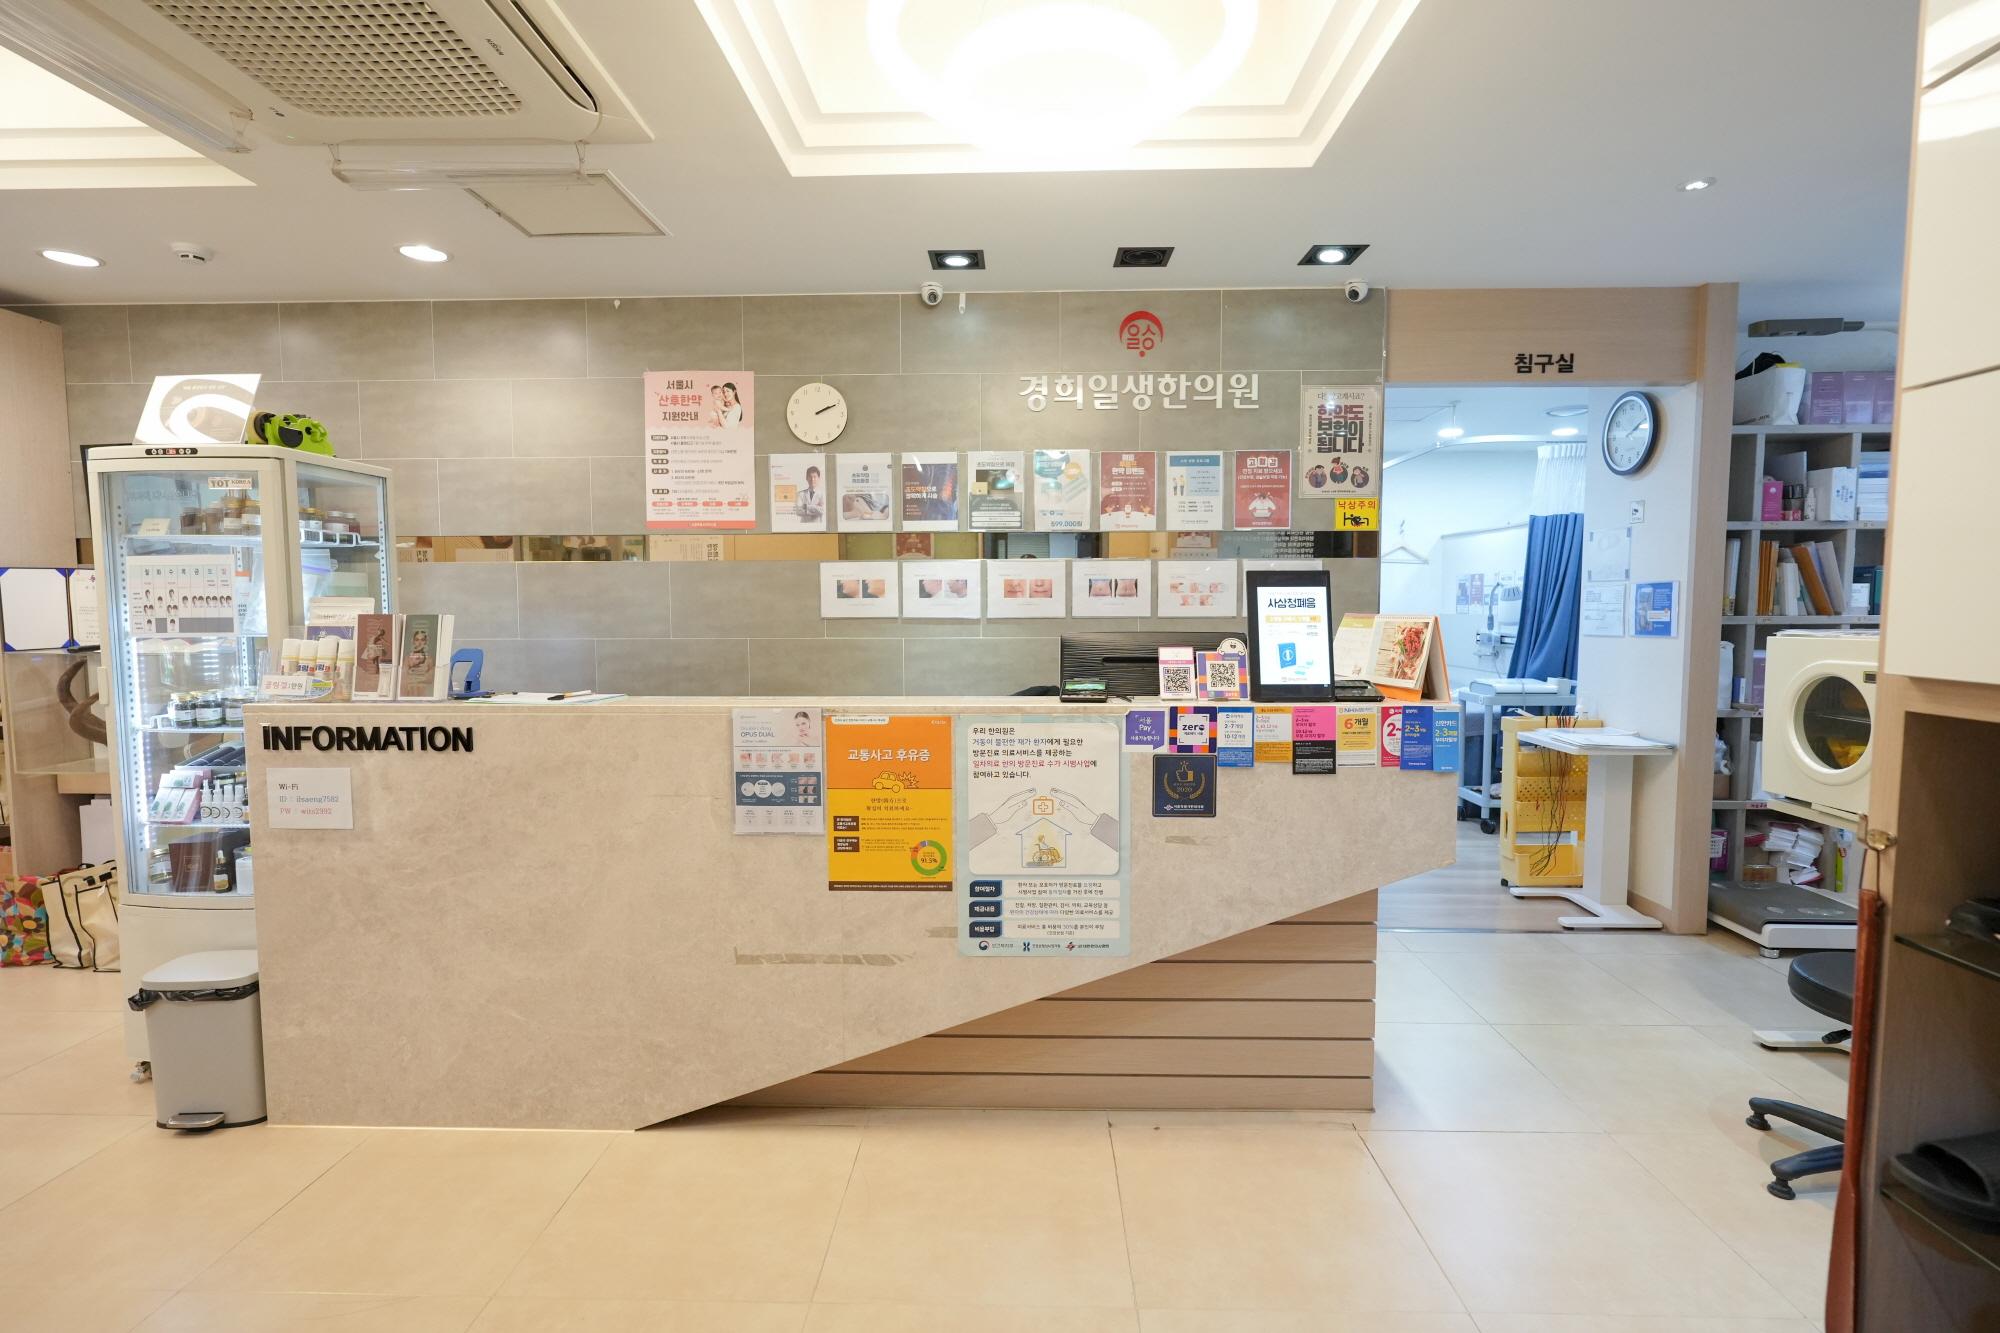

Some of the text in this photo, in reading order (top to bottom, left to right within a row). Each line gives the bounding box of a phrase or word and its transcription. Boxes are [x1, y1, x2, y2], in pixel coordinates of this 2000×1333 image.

[1514, 353, 1574, 374] 침구실
[666, 380, 693, 390] 서울시
[1019, 374, 1260, 412] 경희일생한의원
[659, 394, 703, 406] 산후한약
[662, 411, 699, 421] 지원안내
[1317, 436, 1364, 453] 됩니다
[210, 480, 230, 488] YOT
[1338, 500, 1376, 510] 낙상주의
[1182, 723, 1205, 731] zero
[1344, 718, 1369, 729] 6 개월
[262, 726, 474, 752] INFORMATION
[973, 738, 1083, 746] 거동이 불편한 재가 환자에게 필요한
[847, 749, 930, 762] 교통사고 후유증
[973, 749, 1072, 757] 방문진료 의료서비스를 제공하는
[973, 760, 1096, 768] 일차의료 한의 방문진료 수가 시범사업에
